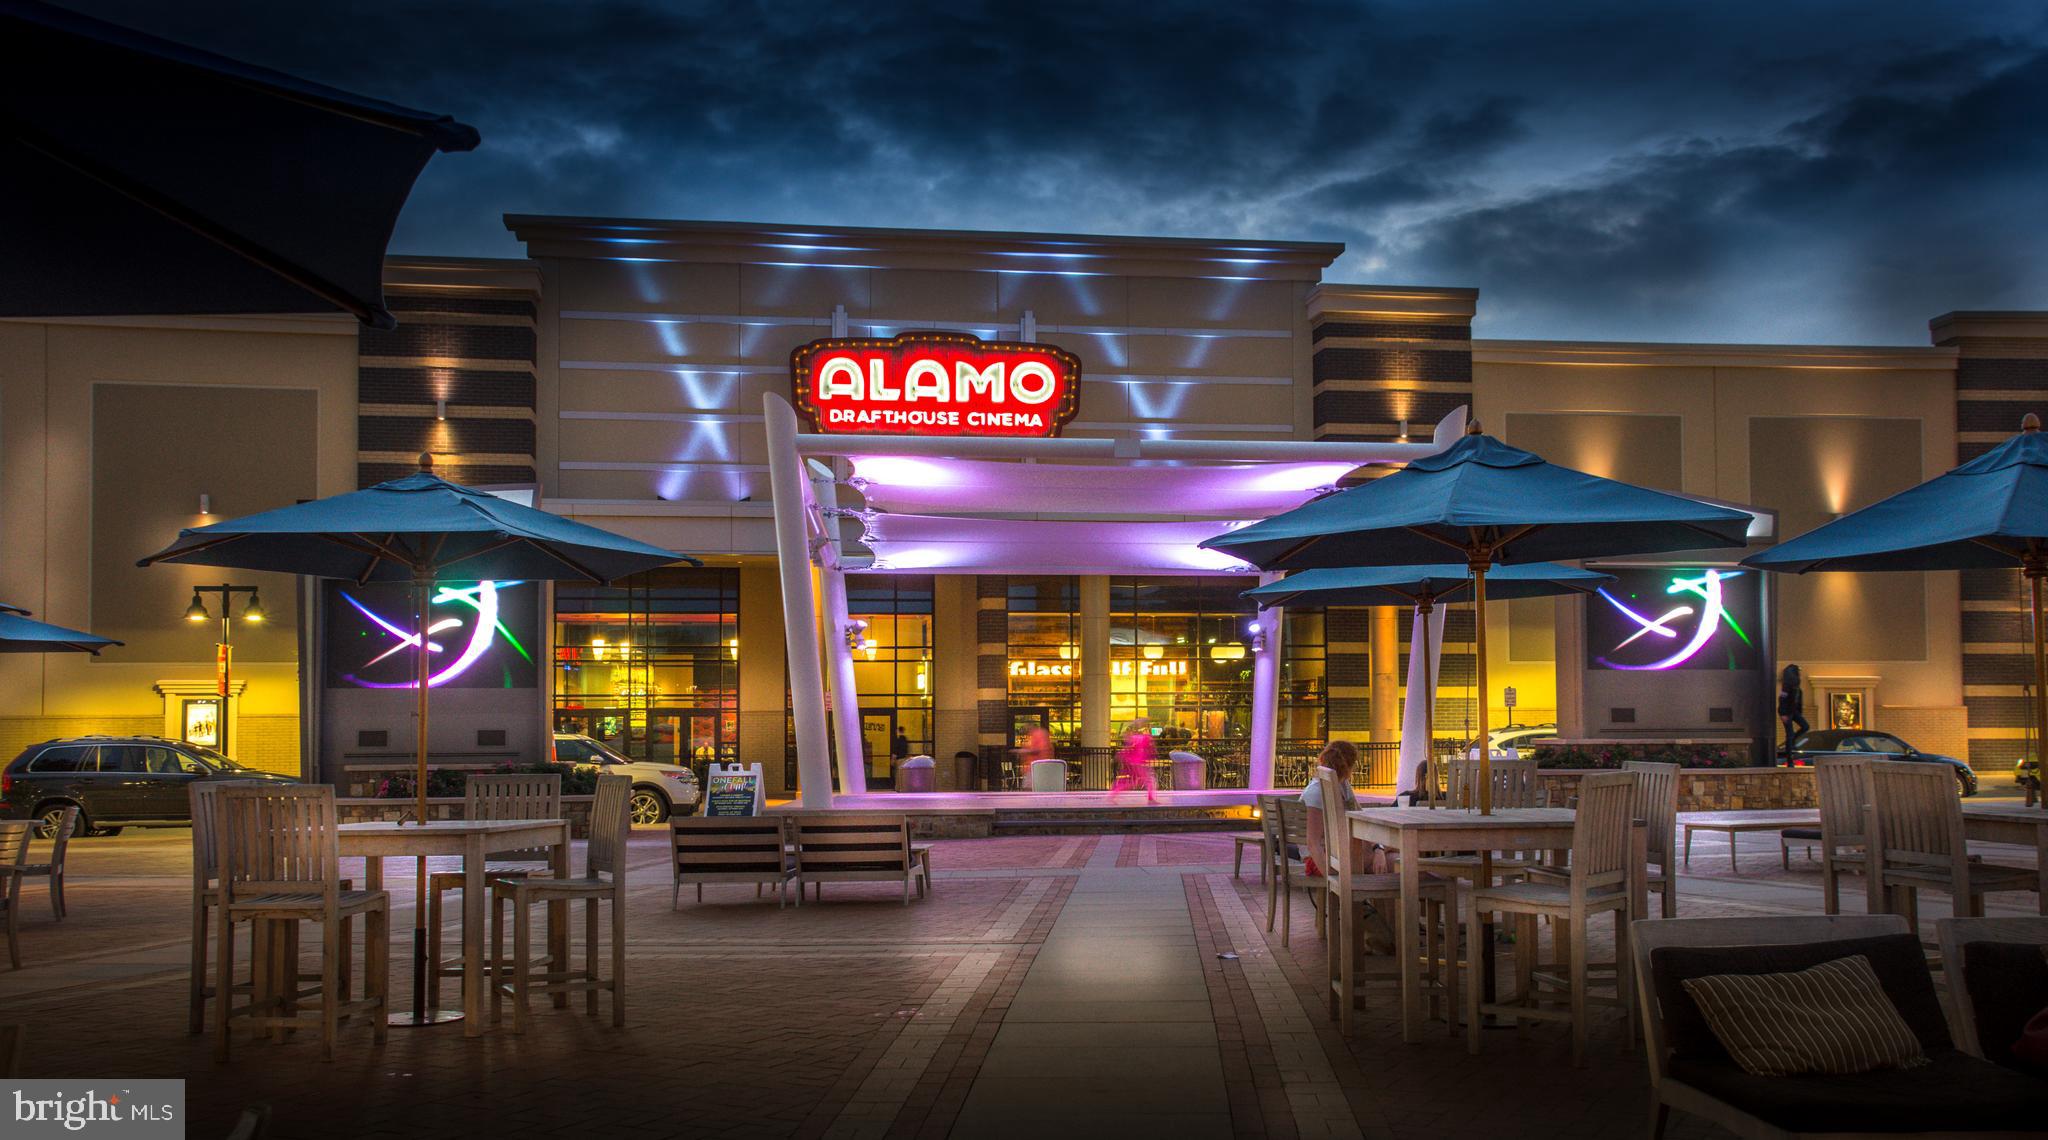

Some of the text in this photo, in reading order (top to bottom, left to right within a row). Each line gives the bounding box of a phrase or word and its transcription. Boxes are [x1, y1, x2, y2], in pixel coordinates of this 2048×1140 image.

[819, 357, 1056, 404] ALAMO
[829, 409, 1043, 427] DRAFTHOUSE CINEMA
